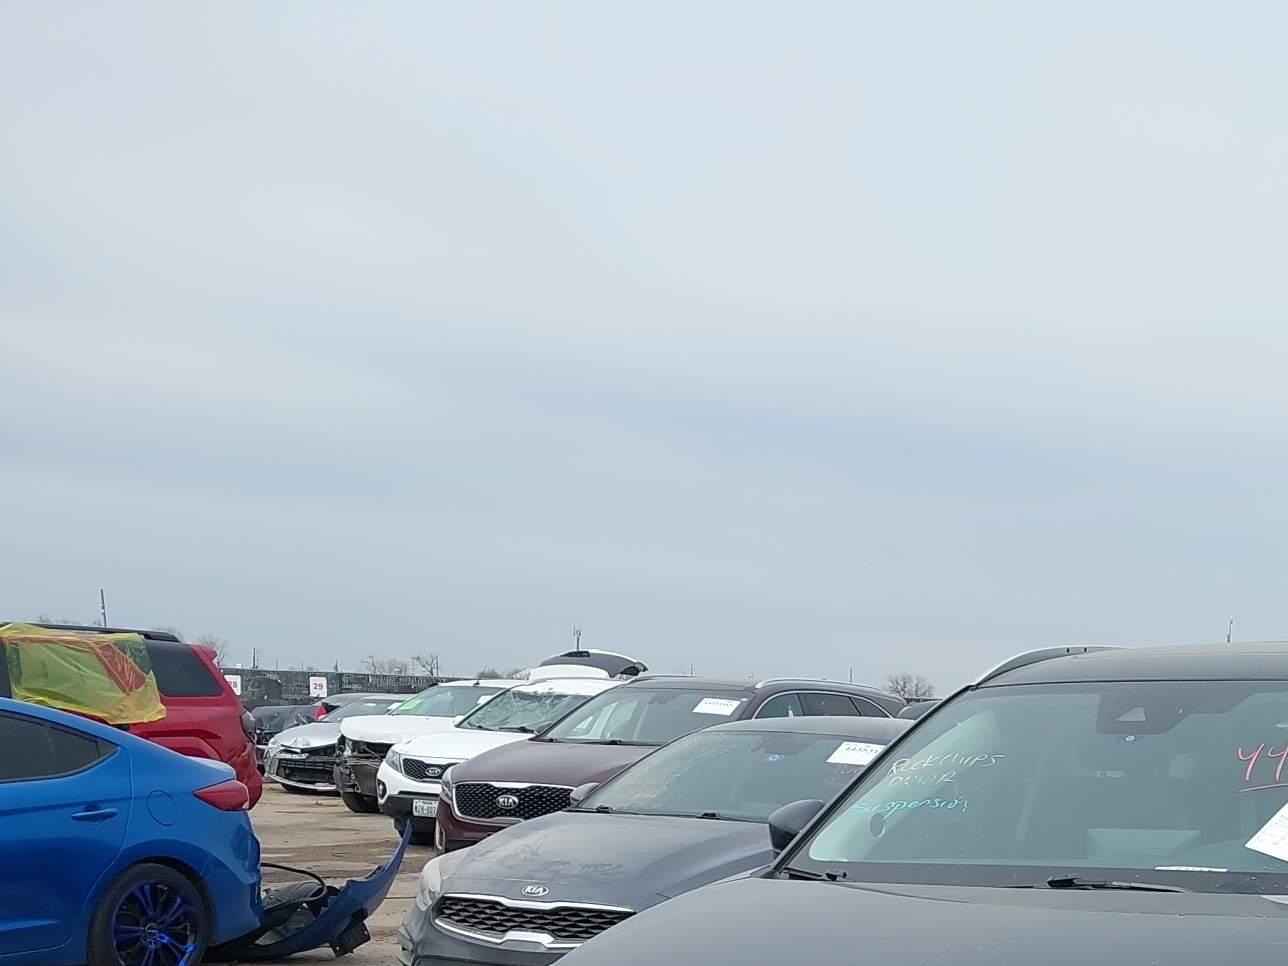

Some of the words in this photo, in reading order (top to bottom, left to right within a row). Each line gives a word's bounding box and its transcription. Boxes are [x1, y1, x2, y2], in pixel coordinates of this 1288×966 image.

[312, 682, 324, 691] 29
[498, 797, 515, 807] KIA
[524, 885, 544, 894] KIA
